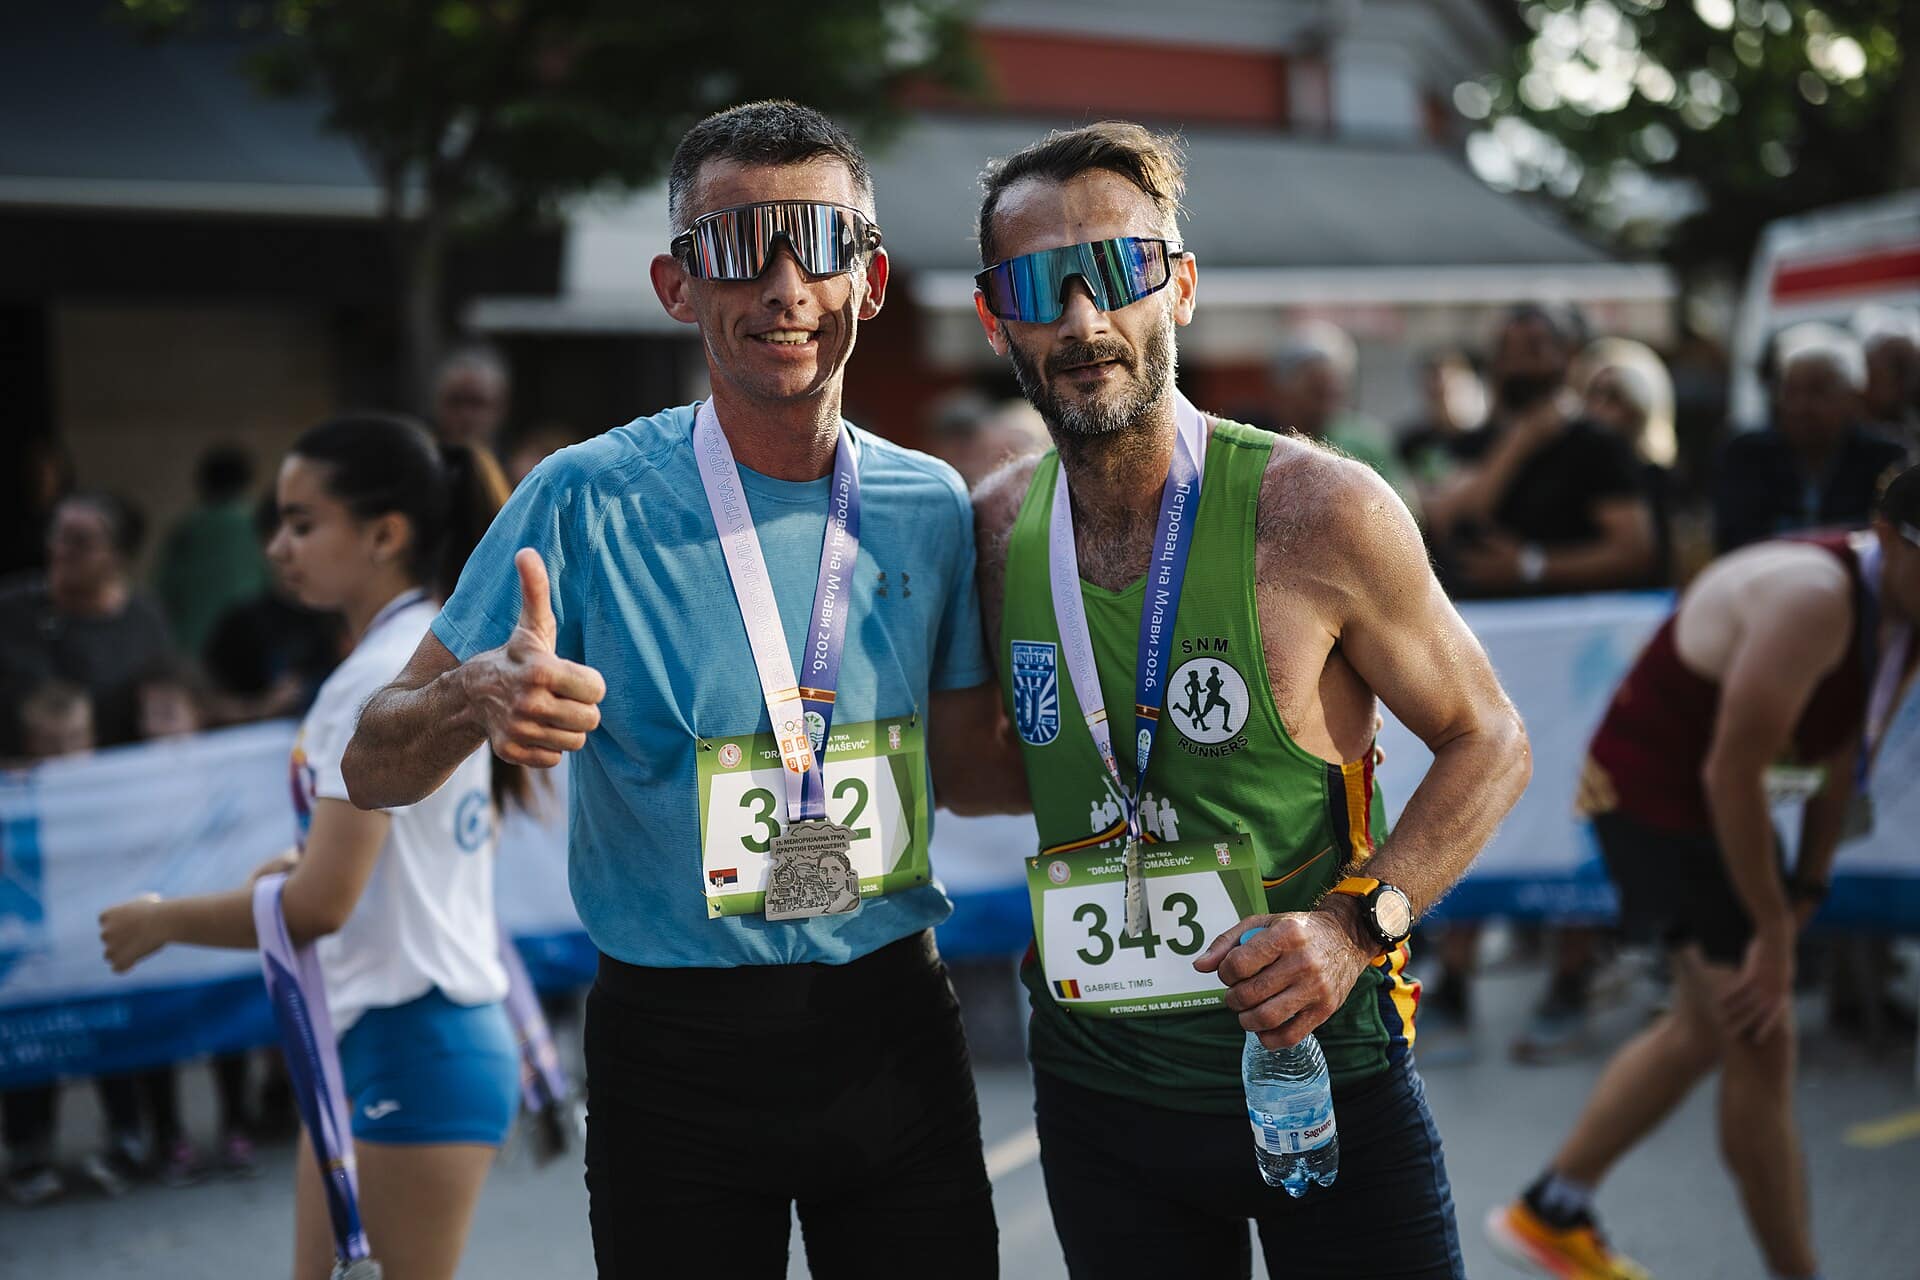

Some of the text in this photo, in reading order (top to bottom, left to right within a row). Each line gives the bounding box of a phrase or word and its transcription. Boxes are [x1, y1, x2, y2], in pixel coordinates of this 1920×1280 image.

[718, 477, 743, 524] ТРКА
[812, 471, 852, 675] Петровац на Млави 2026.
[1144, 482, 1191, 692] Петровац на Млави 2026.
[1181, 637, 1229, 654] SNM
[1015, 653, 1050, 666] UNIREA
[826, 738, 870, 754] MAŠEVIĆ"
[833, 734, 850, 743] TRKA
[1178, 735, 1249, 758] RUNNERS
[739, 777, 872, 854] 32
[1144, 855, 1194, 869] OMAŠEVIĆ"
[1156, 851, 1172, 859] TRKA
[1072, 892, 1205, 966] 343
[1084, 978, 1154, 993] GABRIEL TIMIS
[1109, 1004, 1148, 1014] PETROVAC
[1148, 1002, 1160, 1011] NA
[1160, 1000, 1182, 1010] MLAVI
[1303, 1119, 1332, 1140] Saguaro
